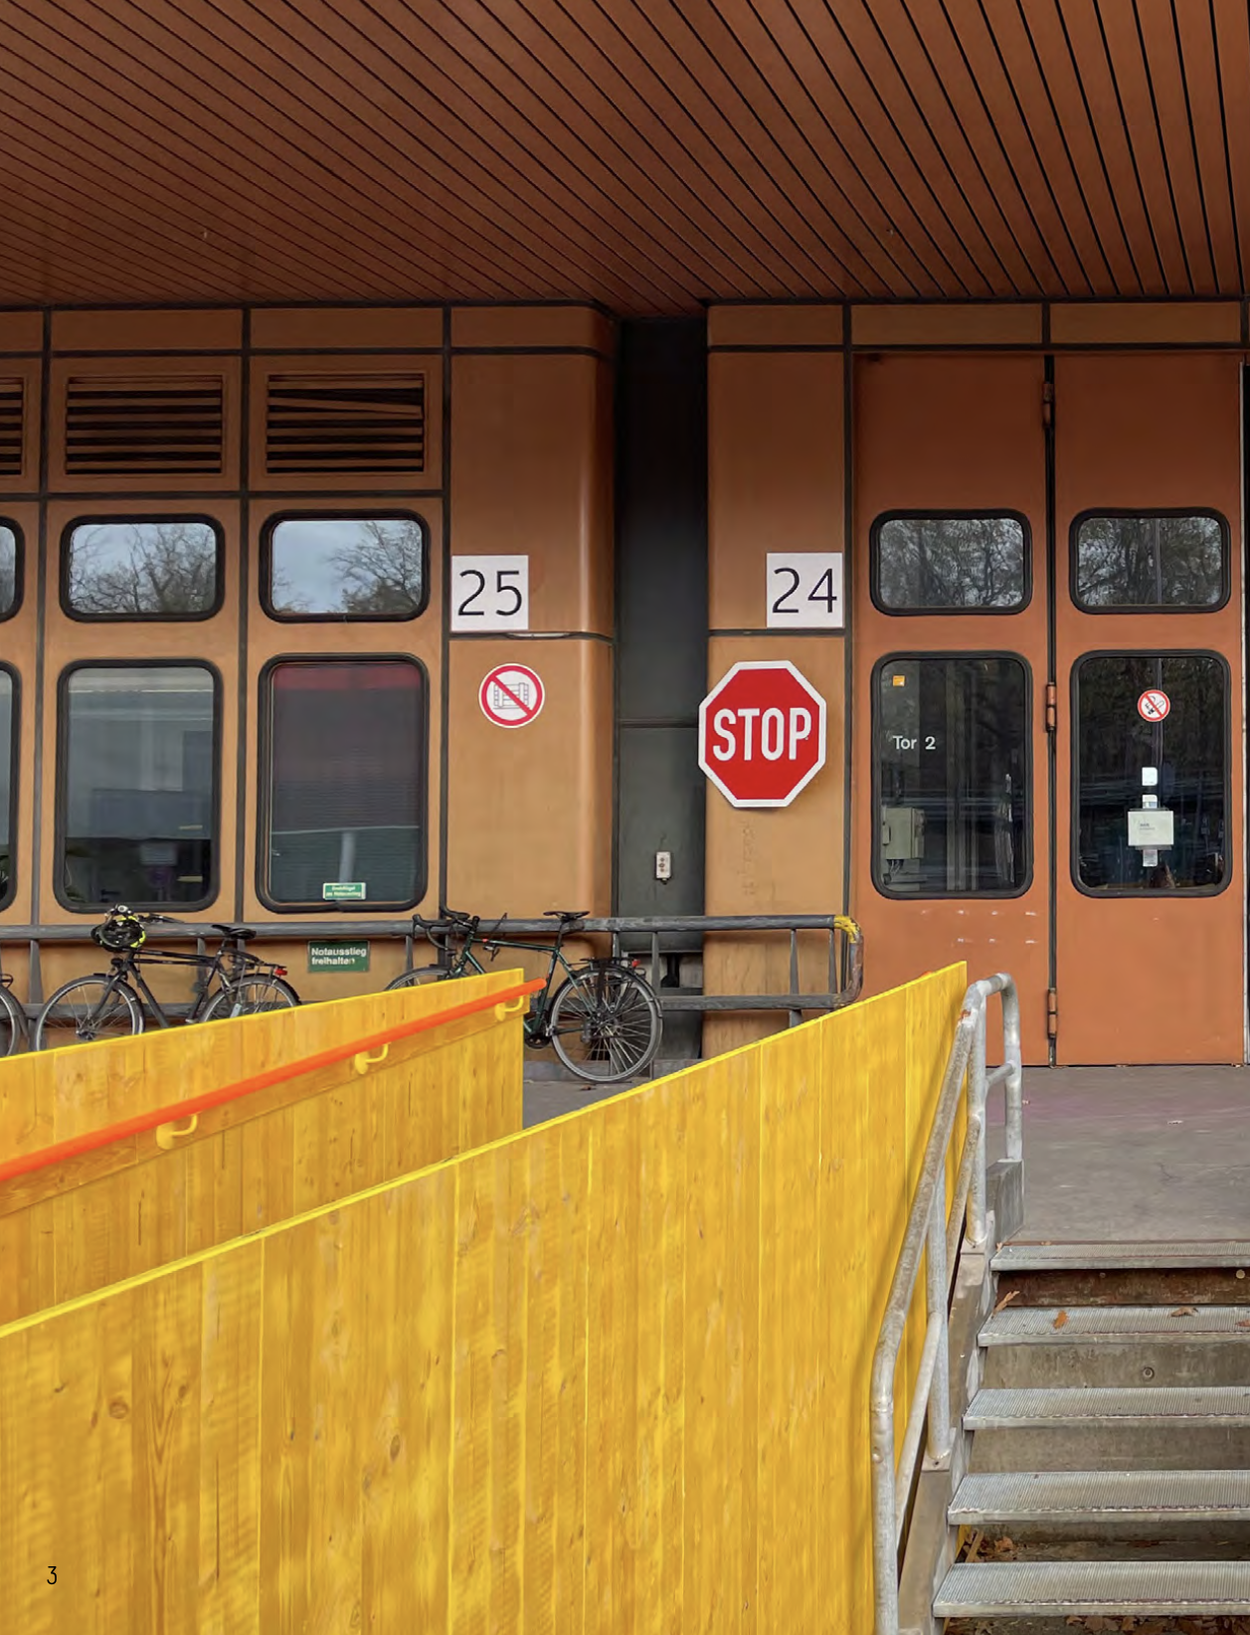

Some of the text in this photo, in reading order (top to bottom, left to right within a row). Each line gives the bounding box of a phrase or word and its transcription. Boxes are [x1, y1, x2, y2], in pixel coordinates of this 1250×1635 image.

[458, 569, 522, 616] 25
[772, 567, 838, 613] 24
[713, 707, 812, 761] STOP
[892, 735, 936, 750] Tor 2
[311, 947, 367, 957] Notausstieg
